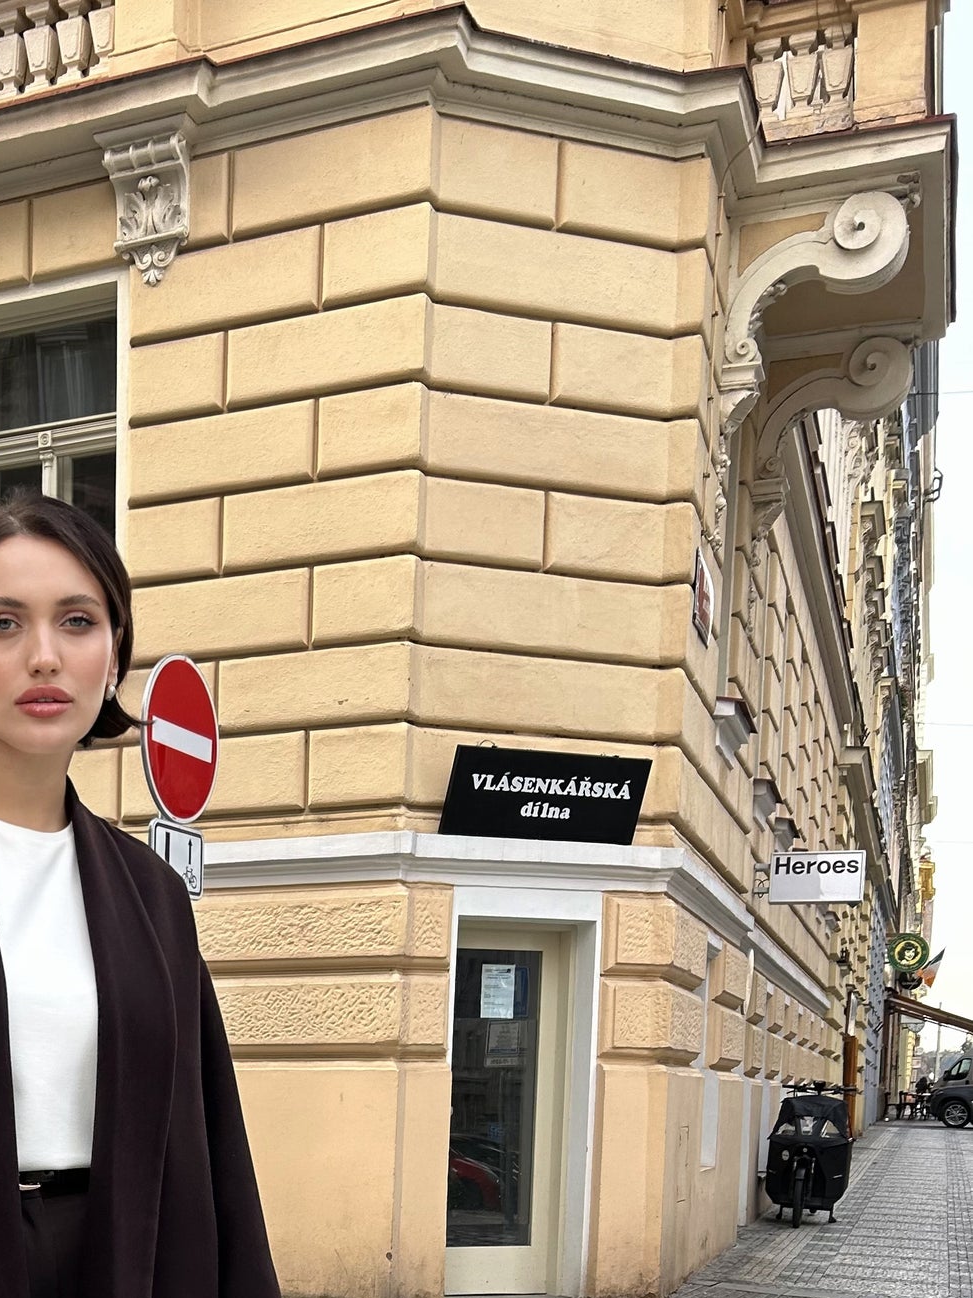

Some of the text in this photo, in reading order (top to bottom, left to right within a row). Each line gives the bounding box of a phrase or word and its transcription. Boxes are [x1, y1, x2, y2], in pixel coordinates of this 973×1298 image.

[472, 771, 631, 799] VLÁSENKÁŘSKÁ
[520, 801, 570, 819] dílna
[775, 856, 859, 875] Heroes
